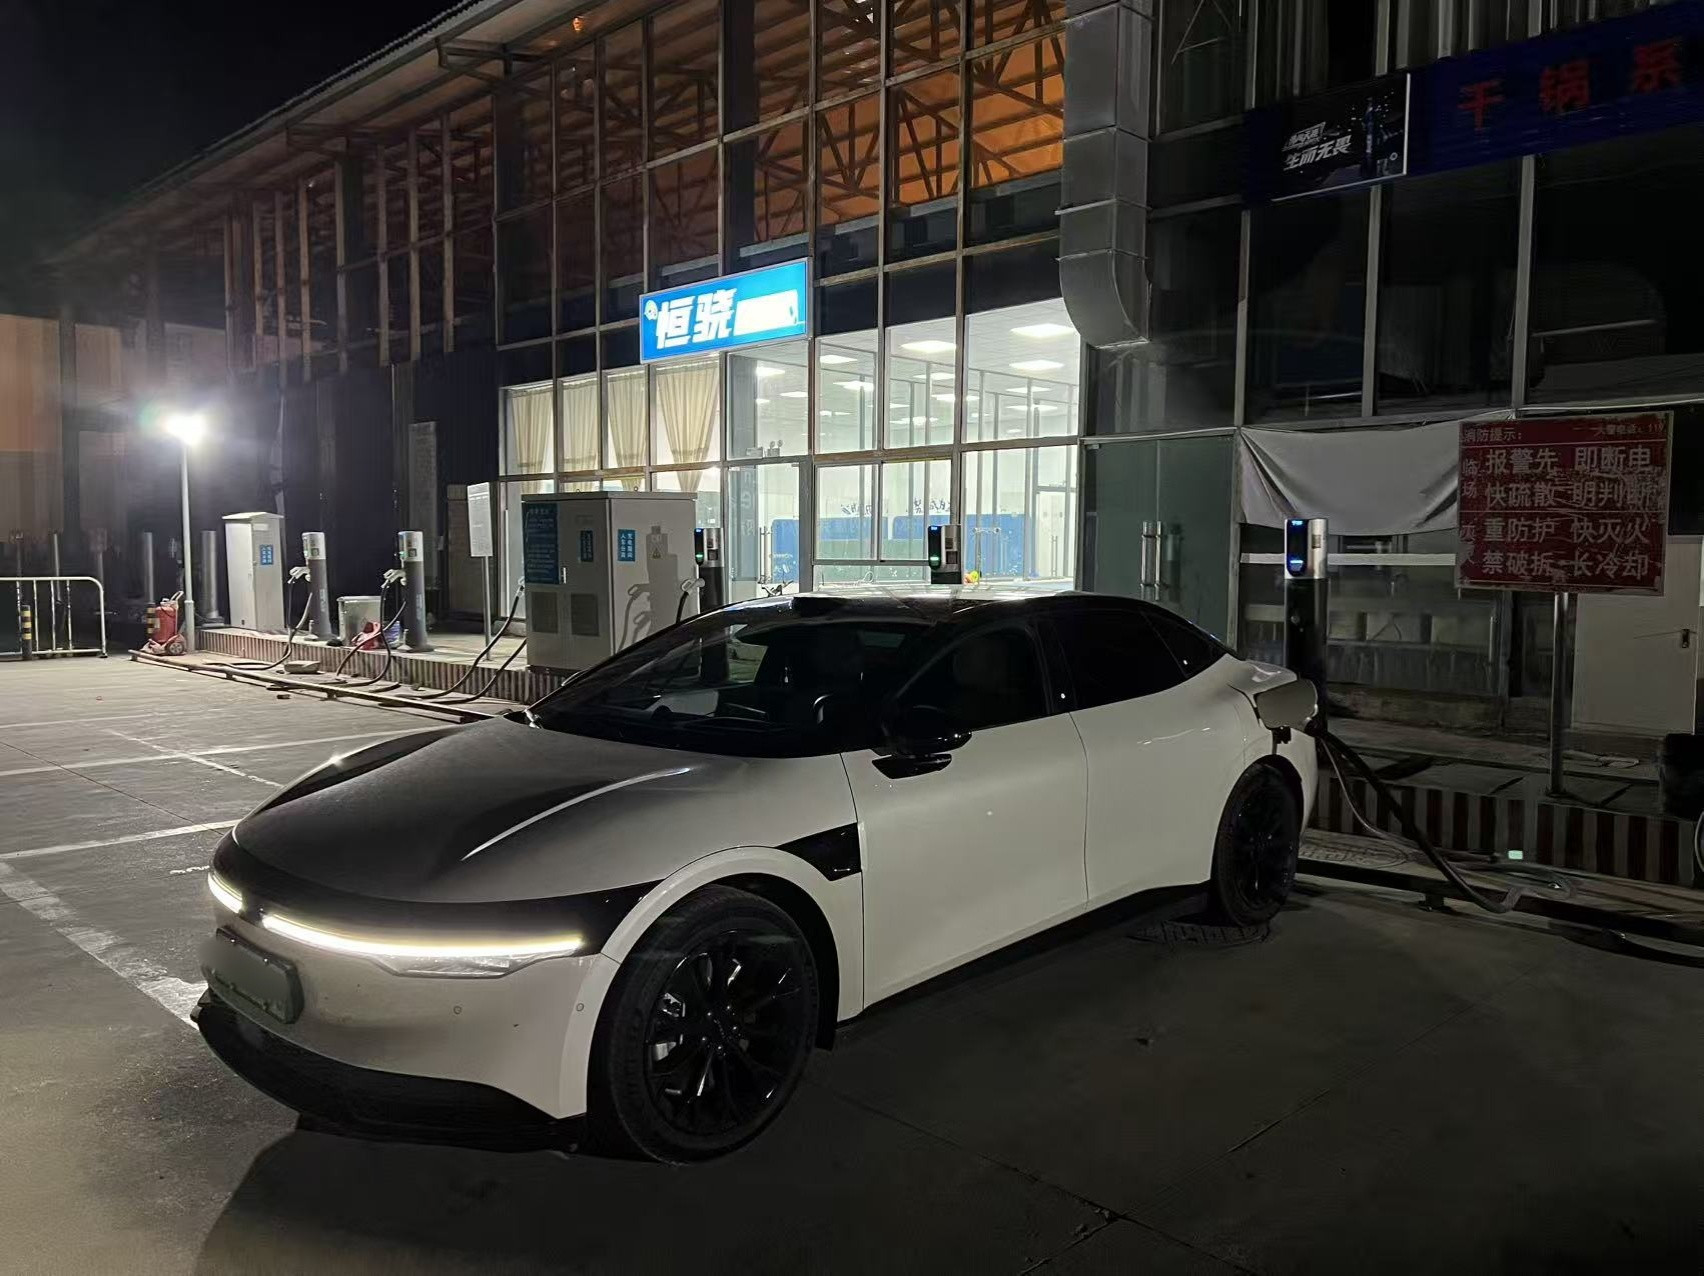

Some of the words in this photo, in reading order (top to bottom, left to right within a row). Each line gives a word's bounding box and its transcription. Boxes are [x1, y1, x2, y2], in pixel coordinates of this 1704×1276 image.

[655, 288, 738, 350] 恒骁
[1484, 447, 1559, 476] 报警先
[1574, 444, 1653, 472] 即断电
[1484, 481, 1557, 508] 快疏散
[1483, 517, 1556, 544] 重防护
[1570, 516, 1651, 545] 快灭火
[1571, 549, 1650, 580] 长冷却
